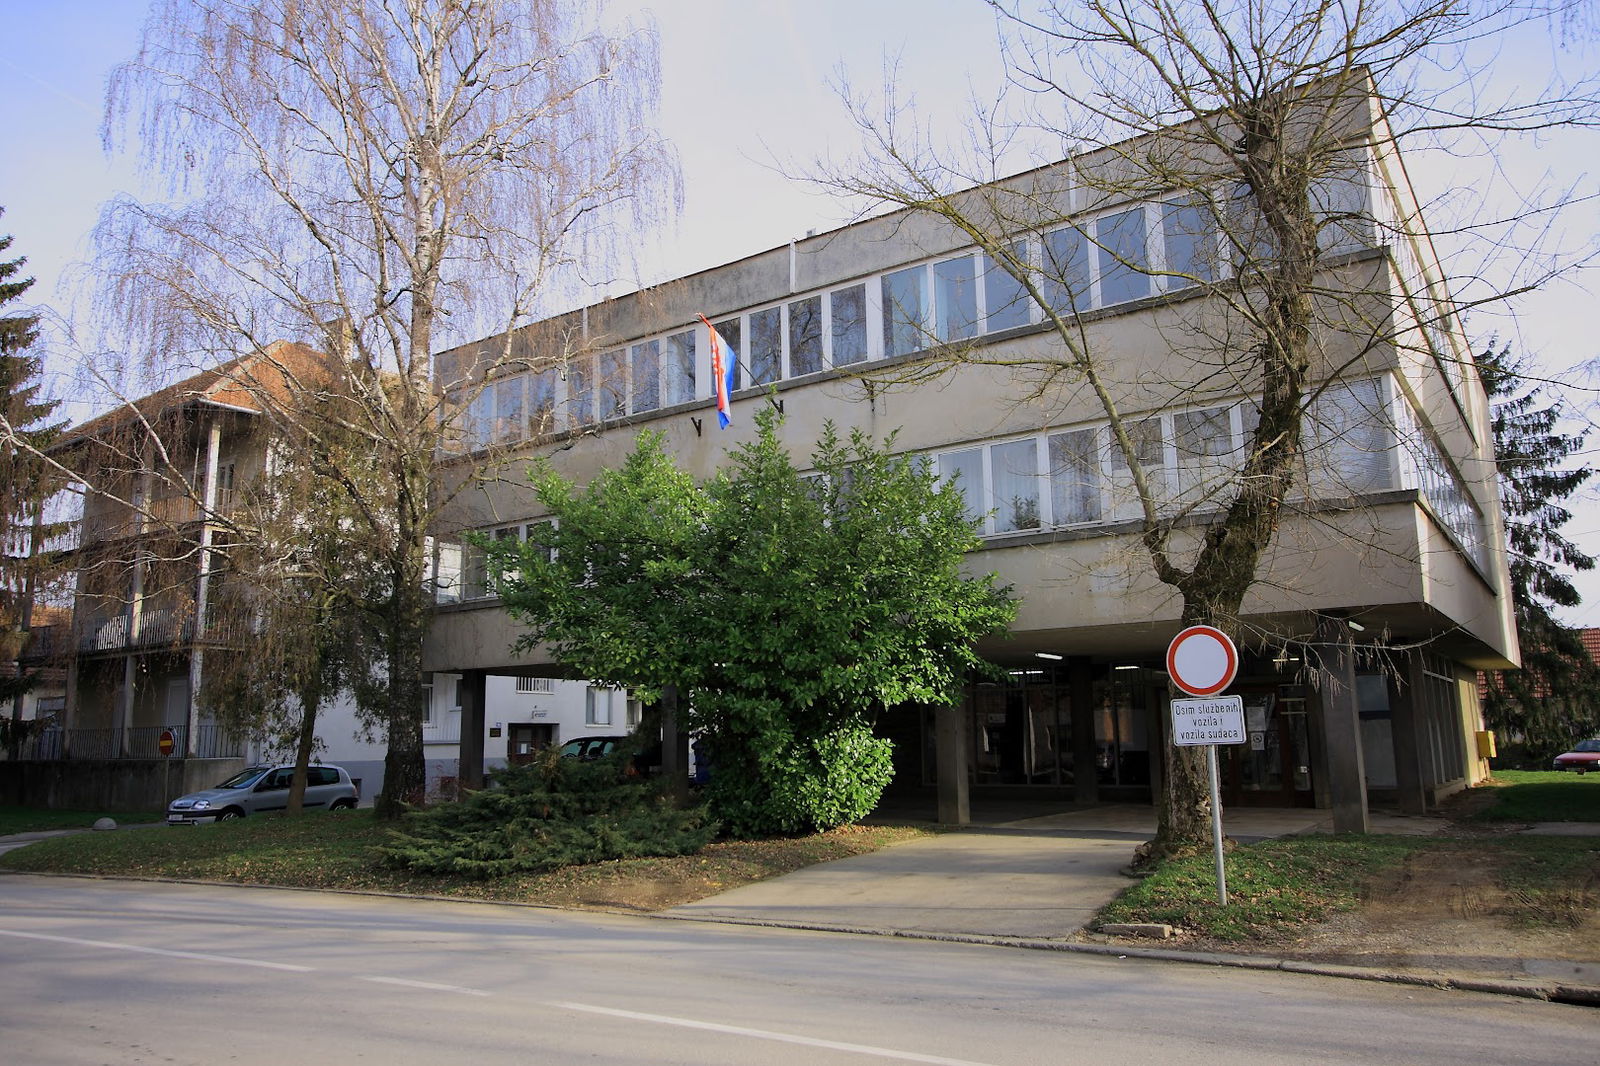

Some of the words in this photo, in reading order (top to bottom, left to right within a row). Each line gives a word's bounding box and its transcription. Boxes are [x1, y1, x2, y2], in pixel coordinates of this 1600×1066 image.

[1175, 705, 1195, 715] Osim
[1198, 702, 1239, 714] službenih
[1192, 716, 1218, 727] vozila
[1180, 729, 1205, 740] vozila
[1208, 729, 1238, 739] sudaca
